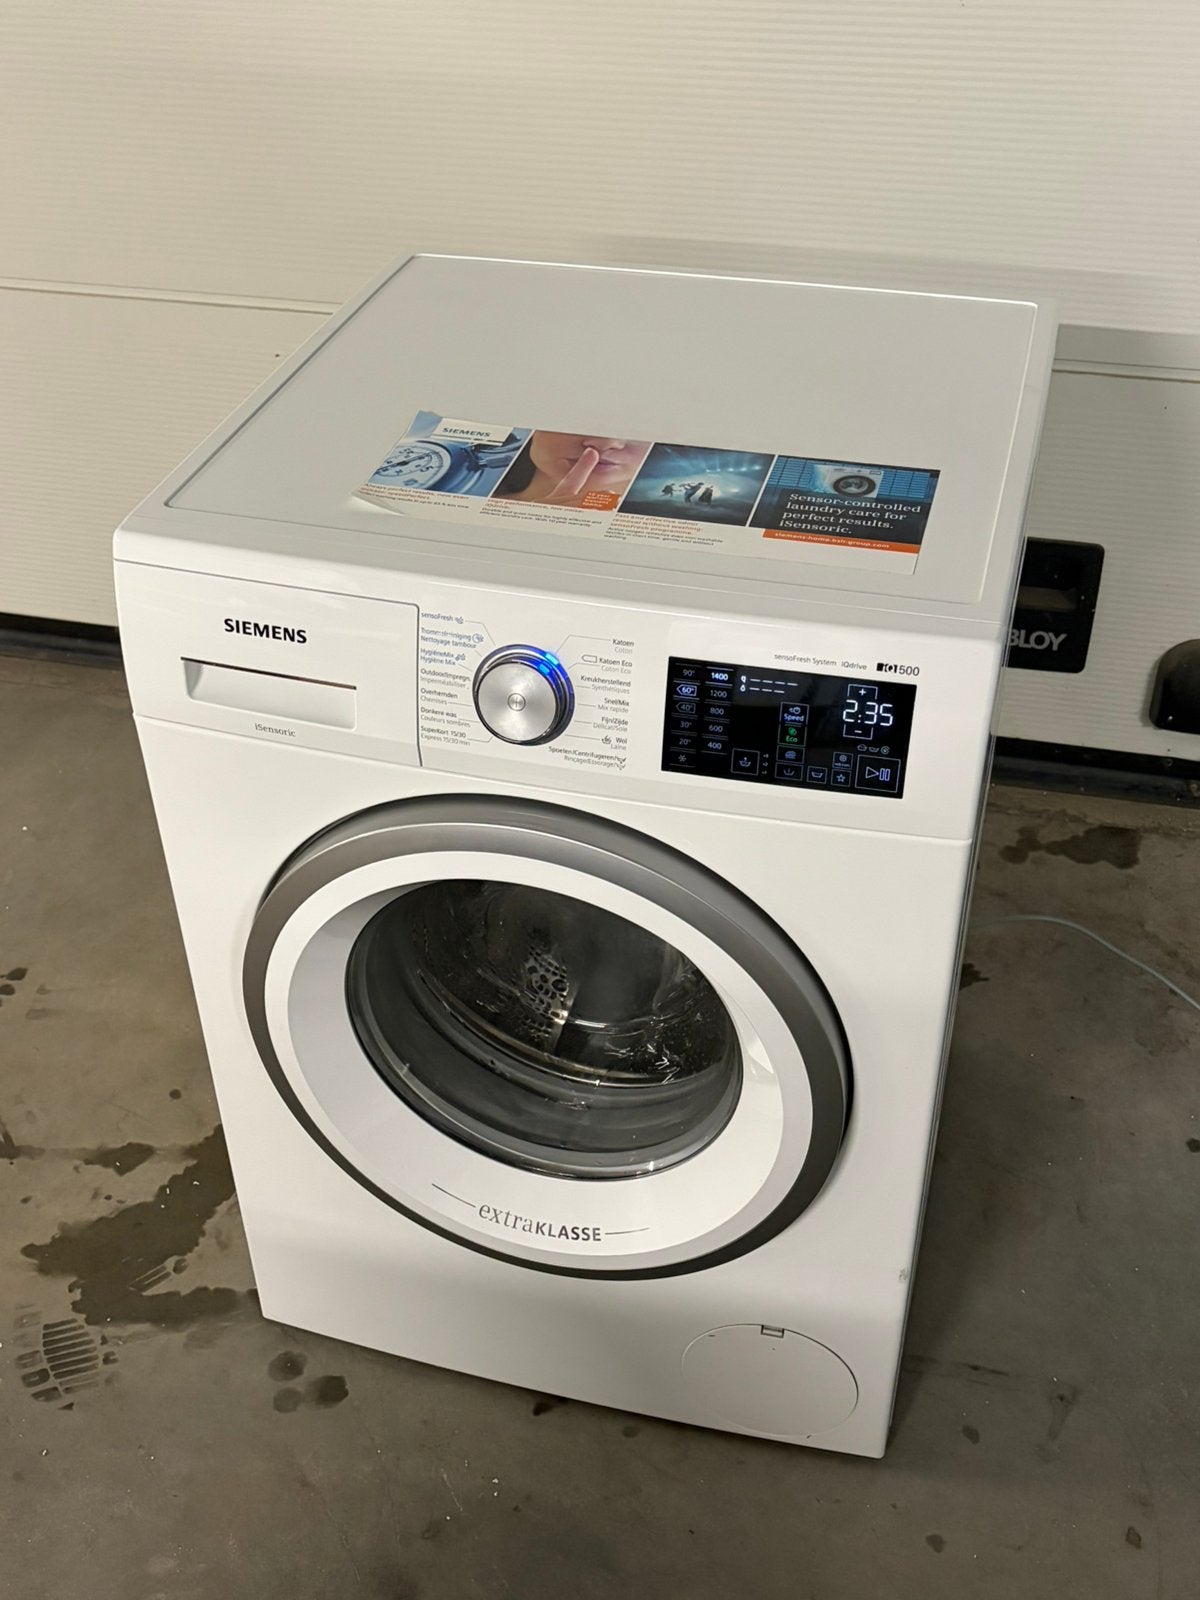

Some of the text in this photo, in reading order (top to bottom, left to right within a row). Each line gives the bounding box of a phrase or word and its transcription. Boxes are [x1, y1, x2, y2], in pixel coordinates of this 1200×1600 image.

[442, 426, 491, 438] SIEMENS
[789, 493, 921, 513] Sensor-controlled
[786, 502, 907, 521] laundry care for
[782, 511, 894, 529] perfect results.
[779, 520, 852, 534] iSensoric.
[224, 618, 308, 644] SIEMENS
[420, 634, 450, 646] Nettoyage
[612, 638, 634, 647] Katoen
[599, 657, 620, 666] Katoen
[774, 653, 868, 671] sensoFresh System iQdrive
[580, 674, 632, 688] Kreukherstellend
[711, 672, 729, 682] 1400
[420, 688, 458, 698] Overhemden
[710, 689, 728, 698] 1200
[420, 706, 444, 716] Donkere
[609, 706, 629, 714] rapide
[710, 706, 724, 716] 800
[842, 700, 894, 727] 2:35
[784, 713, 805, 722] Speed
[254, 722, 296, 738] iSensoric
[708, 724, 724, 733] 600
[616, 736, 628, 744] Wol
[707, 741, 722, 750] 400
